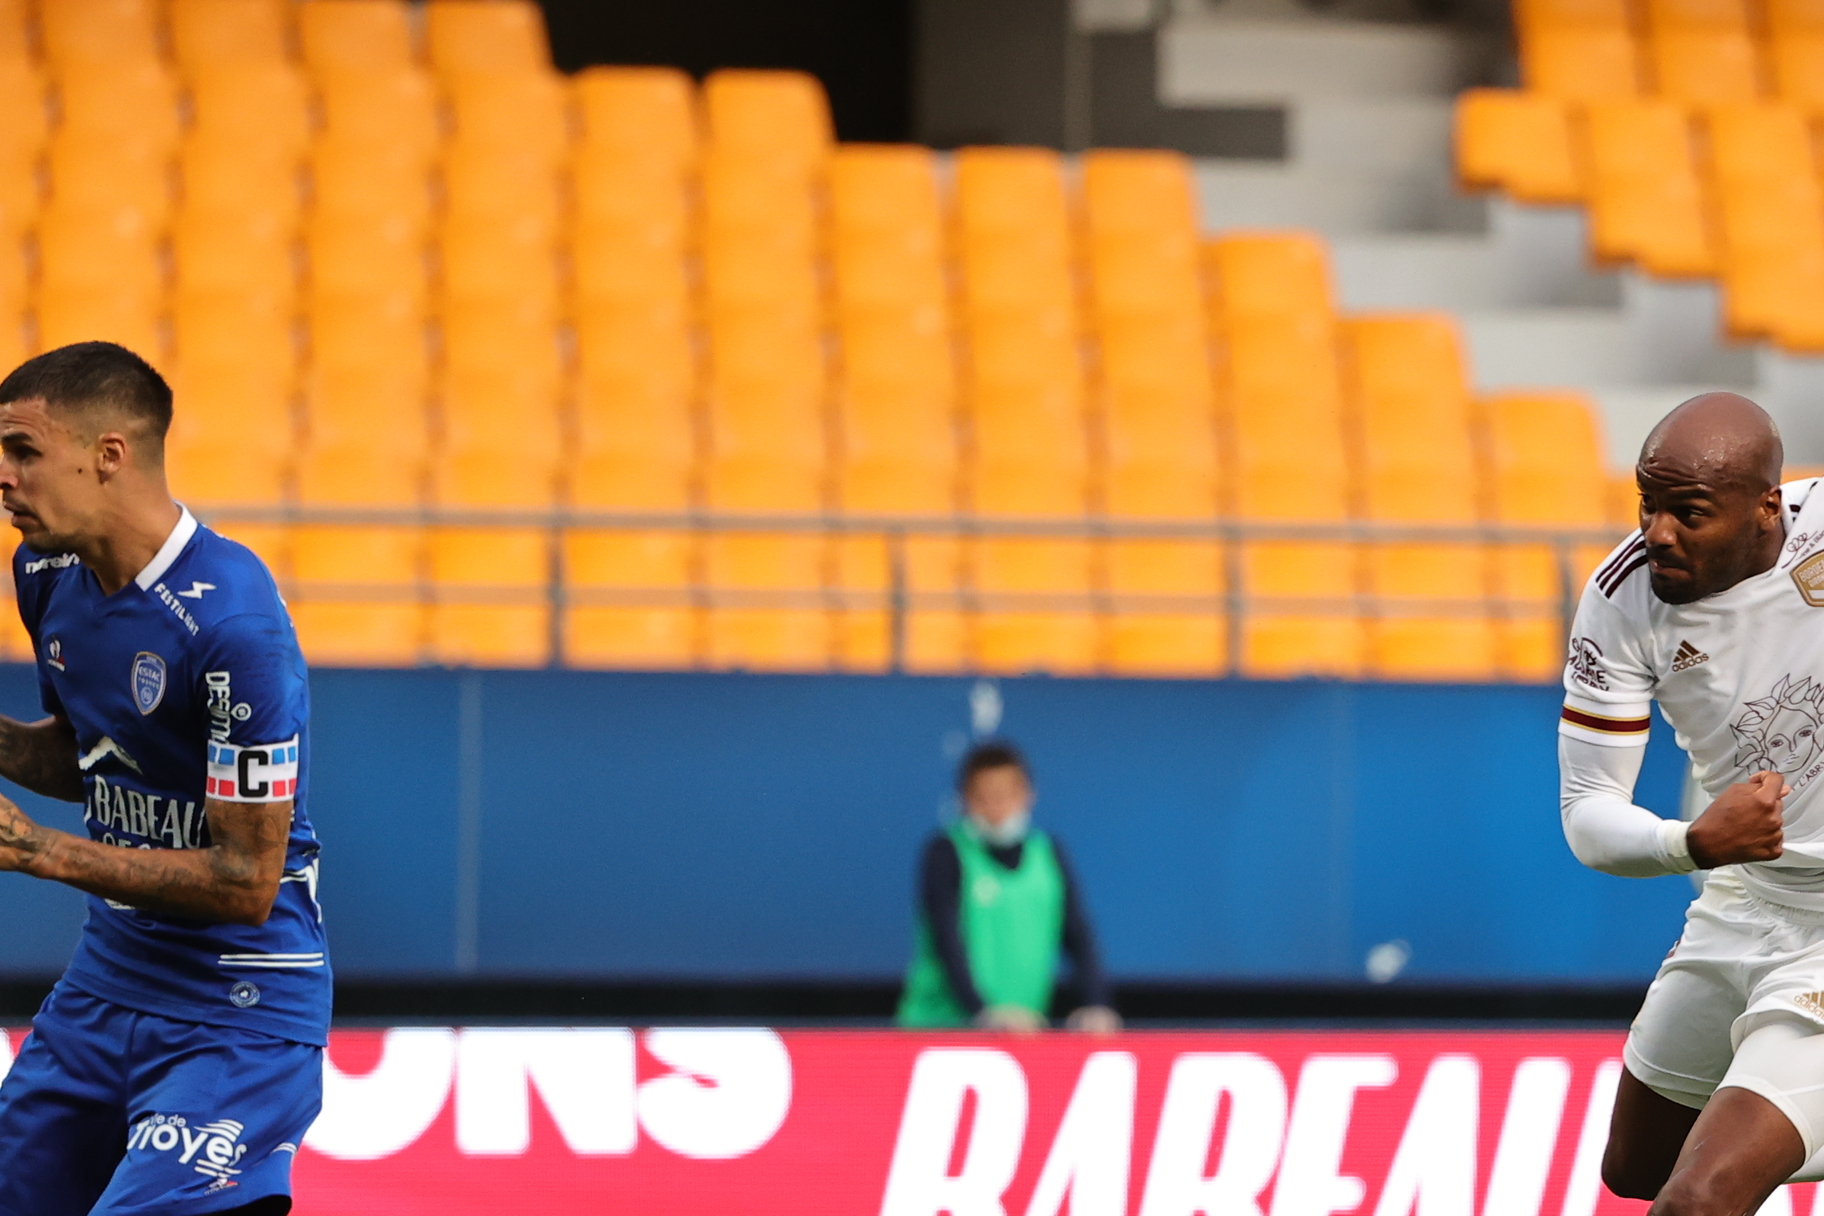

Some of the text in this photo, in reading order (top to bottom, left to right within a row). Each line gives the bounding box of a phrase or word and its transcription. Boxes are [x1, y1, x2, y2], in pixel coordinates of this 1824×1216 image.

[1672, 653, 1710, 672] adidas
[238, 750, 269, 798] C
[95, 773, 206, 849] BABEAU
[127, 1119, 247, 1165] Troyes
